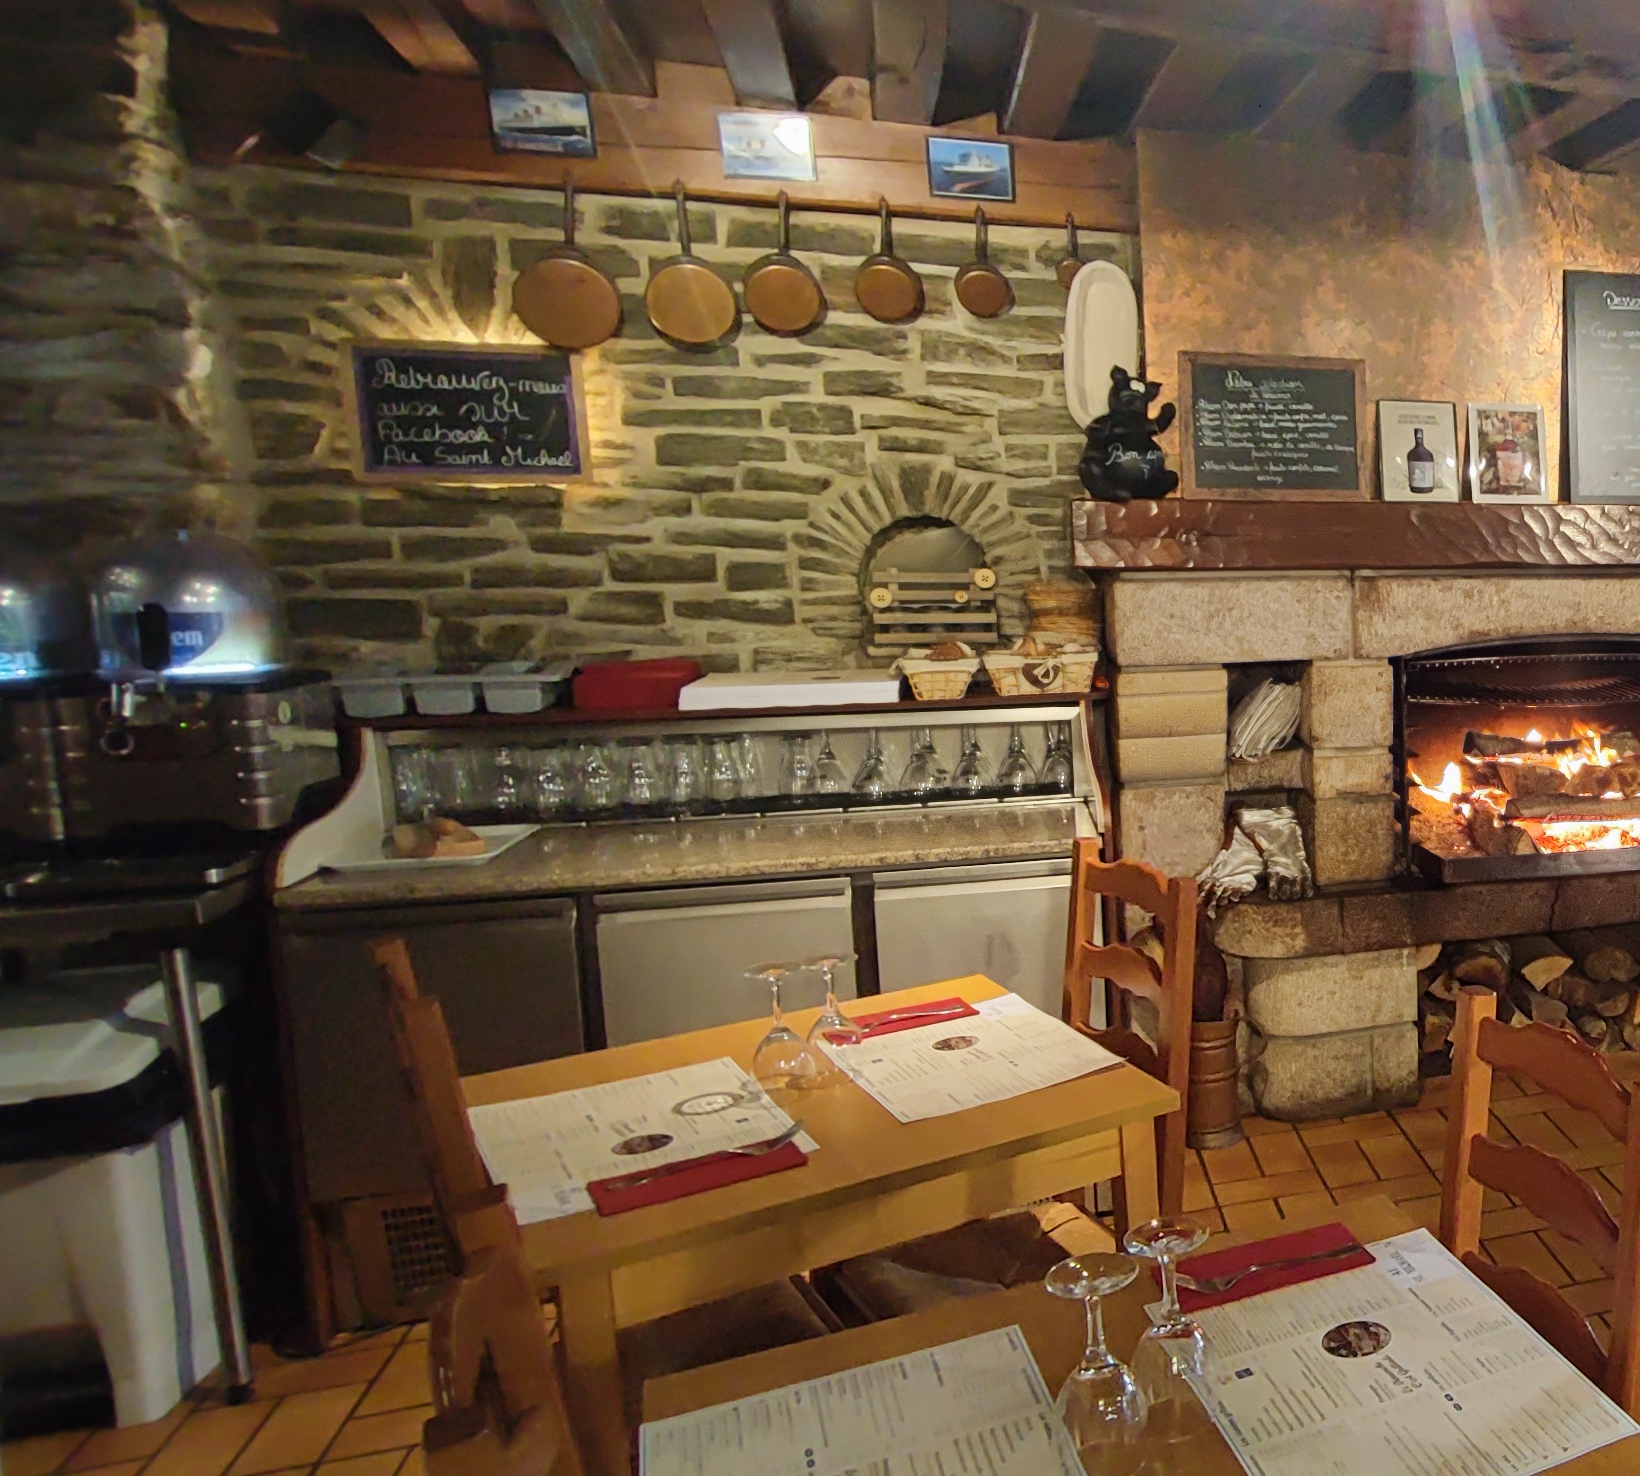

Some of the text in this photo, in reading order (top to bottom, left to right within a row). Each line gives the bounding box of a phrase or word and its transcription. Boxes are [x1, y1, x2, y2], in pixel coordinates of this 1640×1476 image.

[459, 401, 531, 423] sur
[383, 445, 422, 467] Au
[434, 445, 493, 466] Saint
